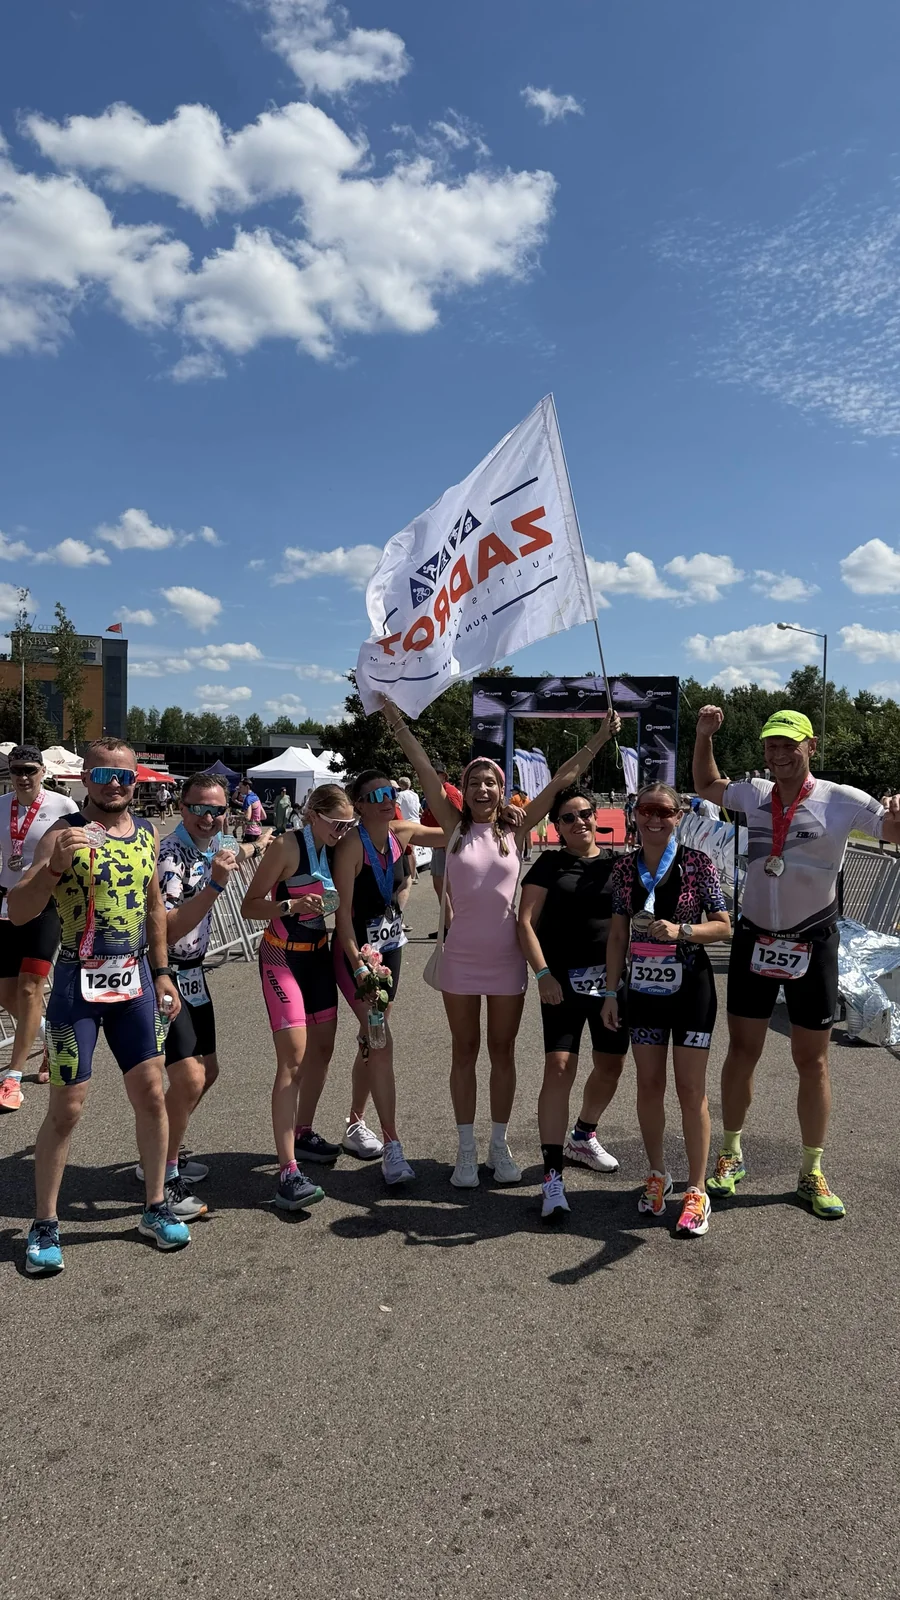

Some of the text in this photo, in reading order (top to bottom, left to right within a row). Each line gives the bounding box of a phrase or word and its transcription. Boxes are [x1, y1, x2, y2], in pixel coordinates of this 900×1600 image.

[370, 923, 401, 943] 3062
[758, 947, 801, 968] 1257
[86, 971, 132, 989] 1260
[634, 966, 676, 982] 3229
